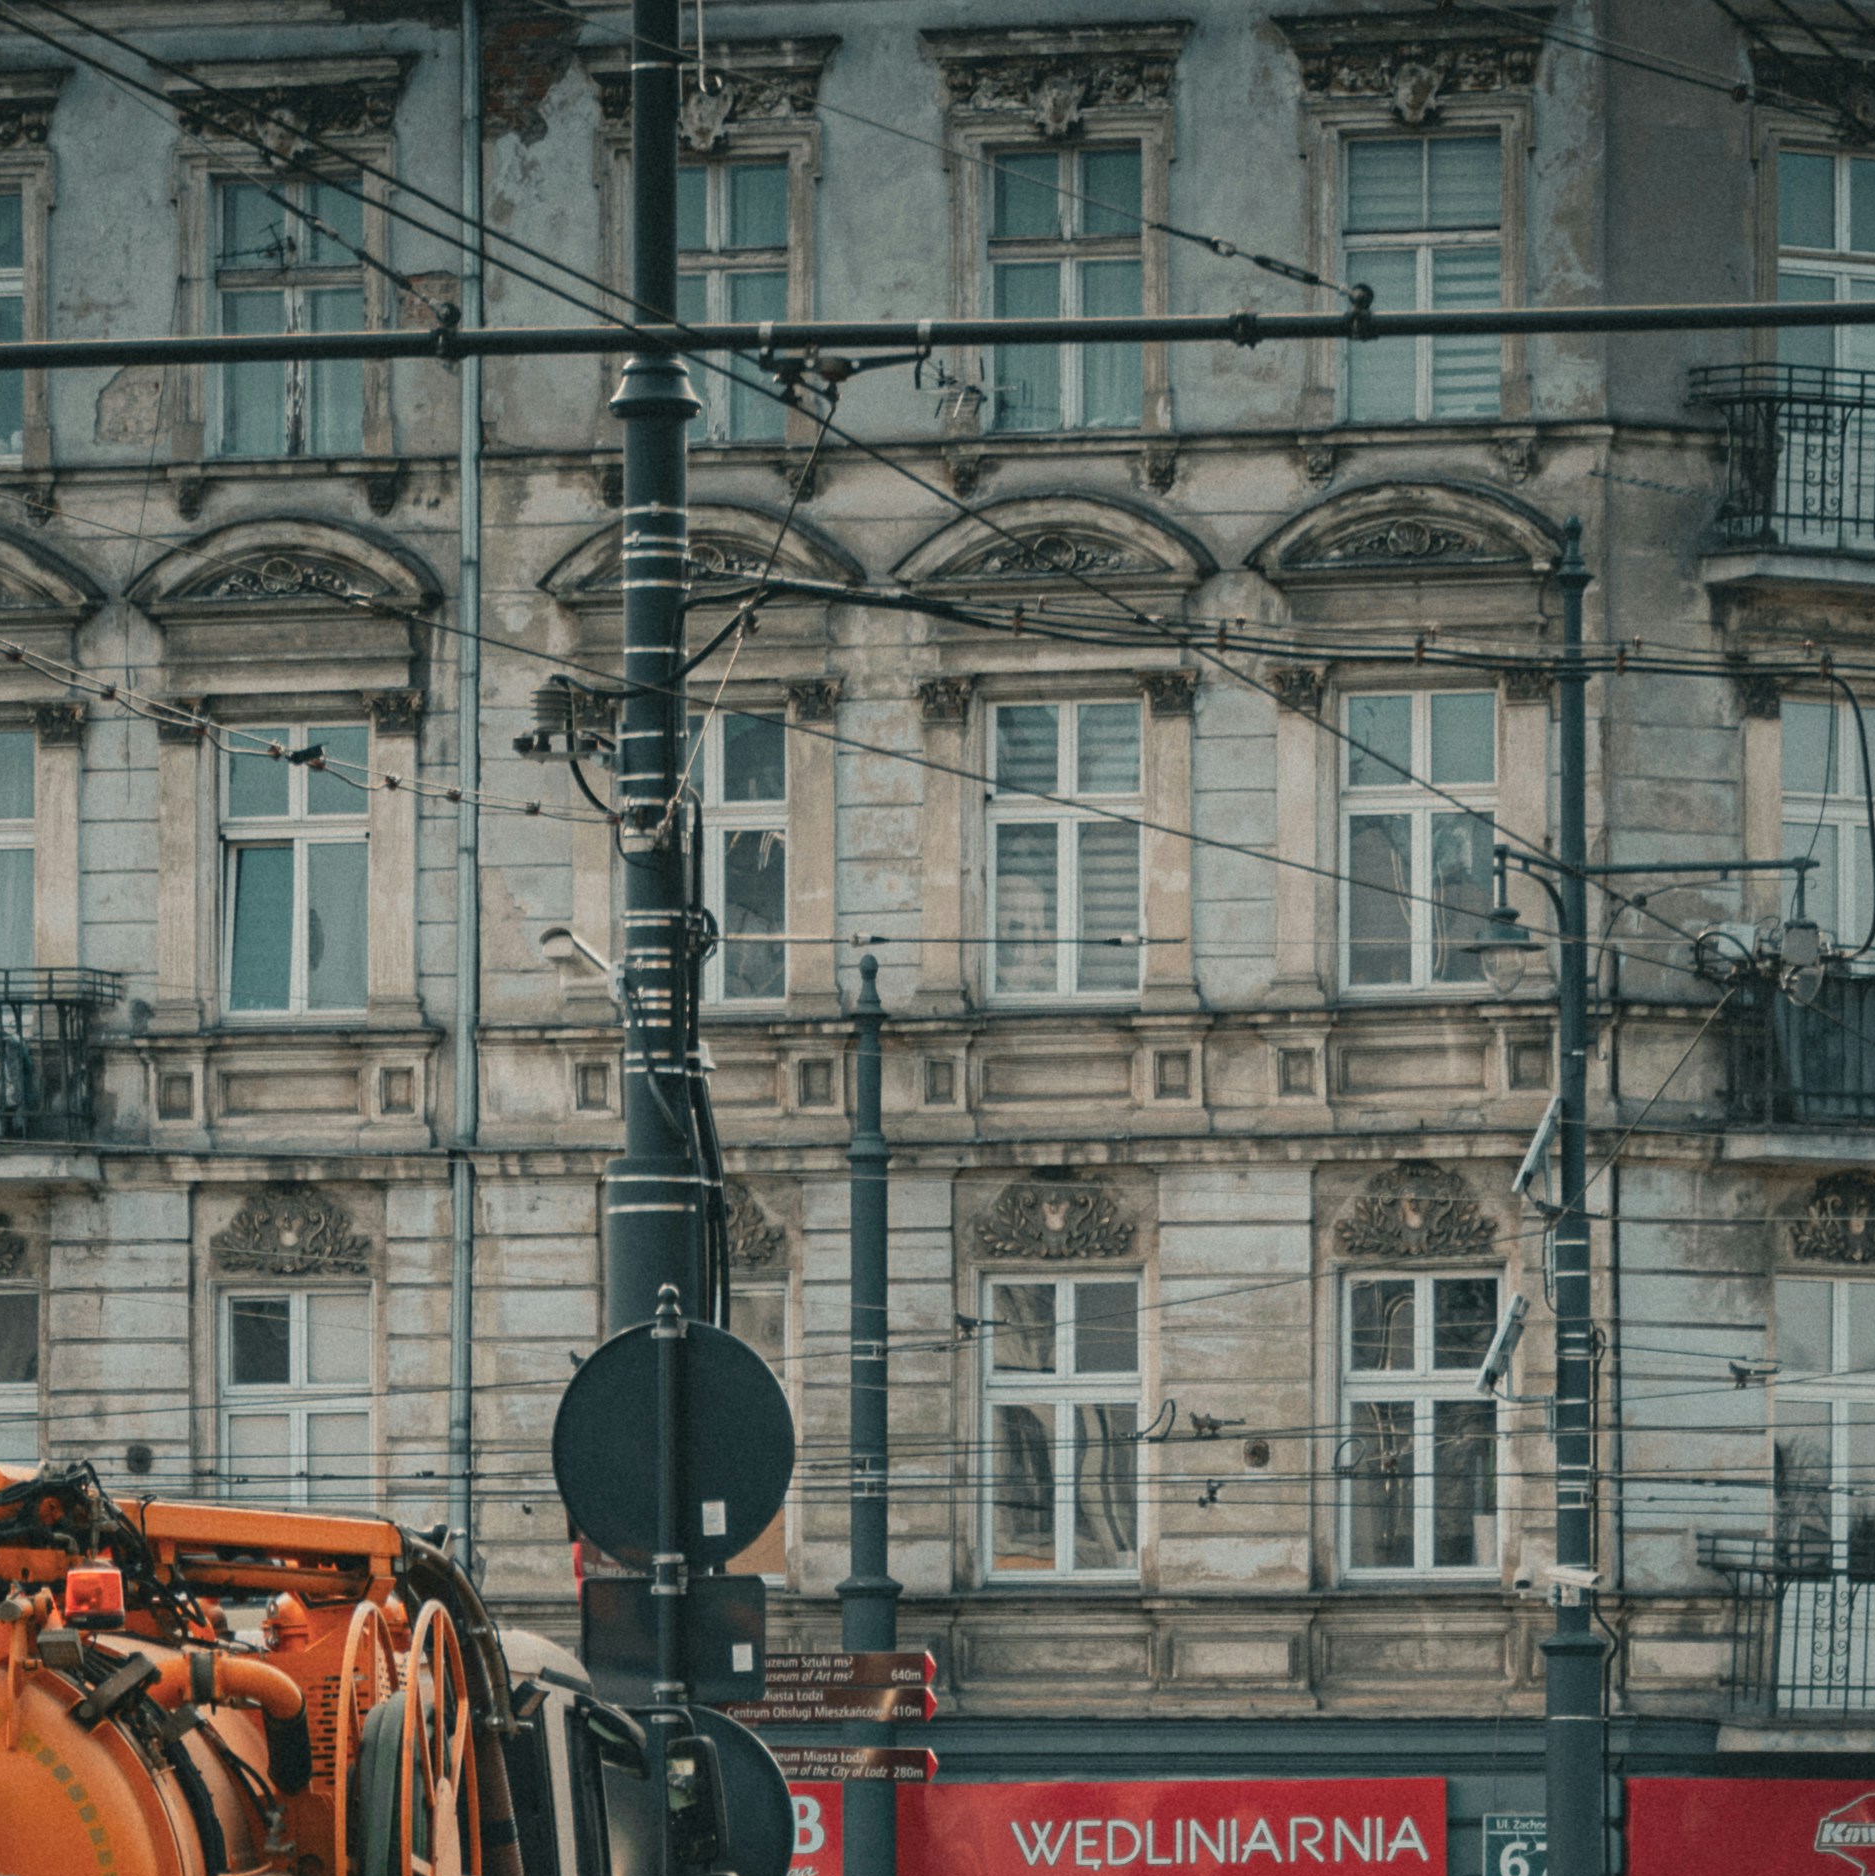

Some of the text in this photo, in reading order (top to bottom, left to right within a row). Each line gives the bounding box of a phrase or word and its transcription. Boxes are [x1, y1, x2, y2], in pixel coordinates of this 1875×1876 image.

[765, 1658, 798, 1668] uzeum
[801, 1656, 831, 1668] Sztuki
[765, 1671, 799, 1682] useum
[801, 1670, 814, 1682] of
[815, 1671, 831, 1681] Art
[891, 1670, 921, 1681] 640m
[796, 1690, 823, 1701] Łodzi
[726, 1705, 922, 1721] Centrum Obsługi Mieszkańców 410m
[774, 1752, 800, 1763] zeum
[803, 1751, 838, 1763] Miasta
[784, 1764, 924, 1780] um of the City of Lodz 280m
[791, 1795, 825, 1854] B
[1010, 1816, 1429, 1871] WĘDLINIARNIA
